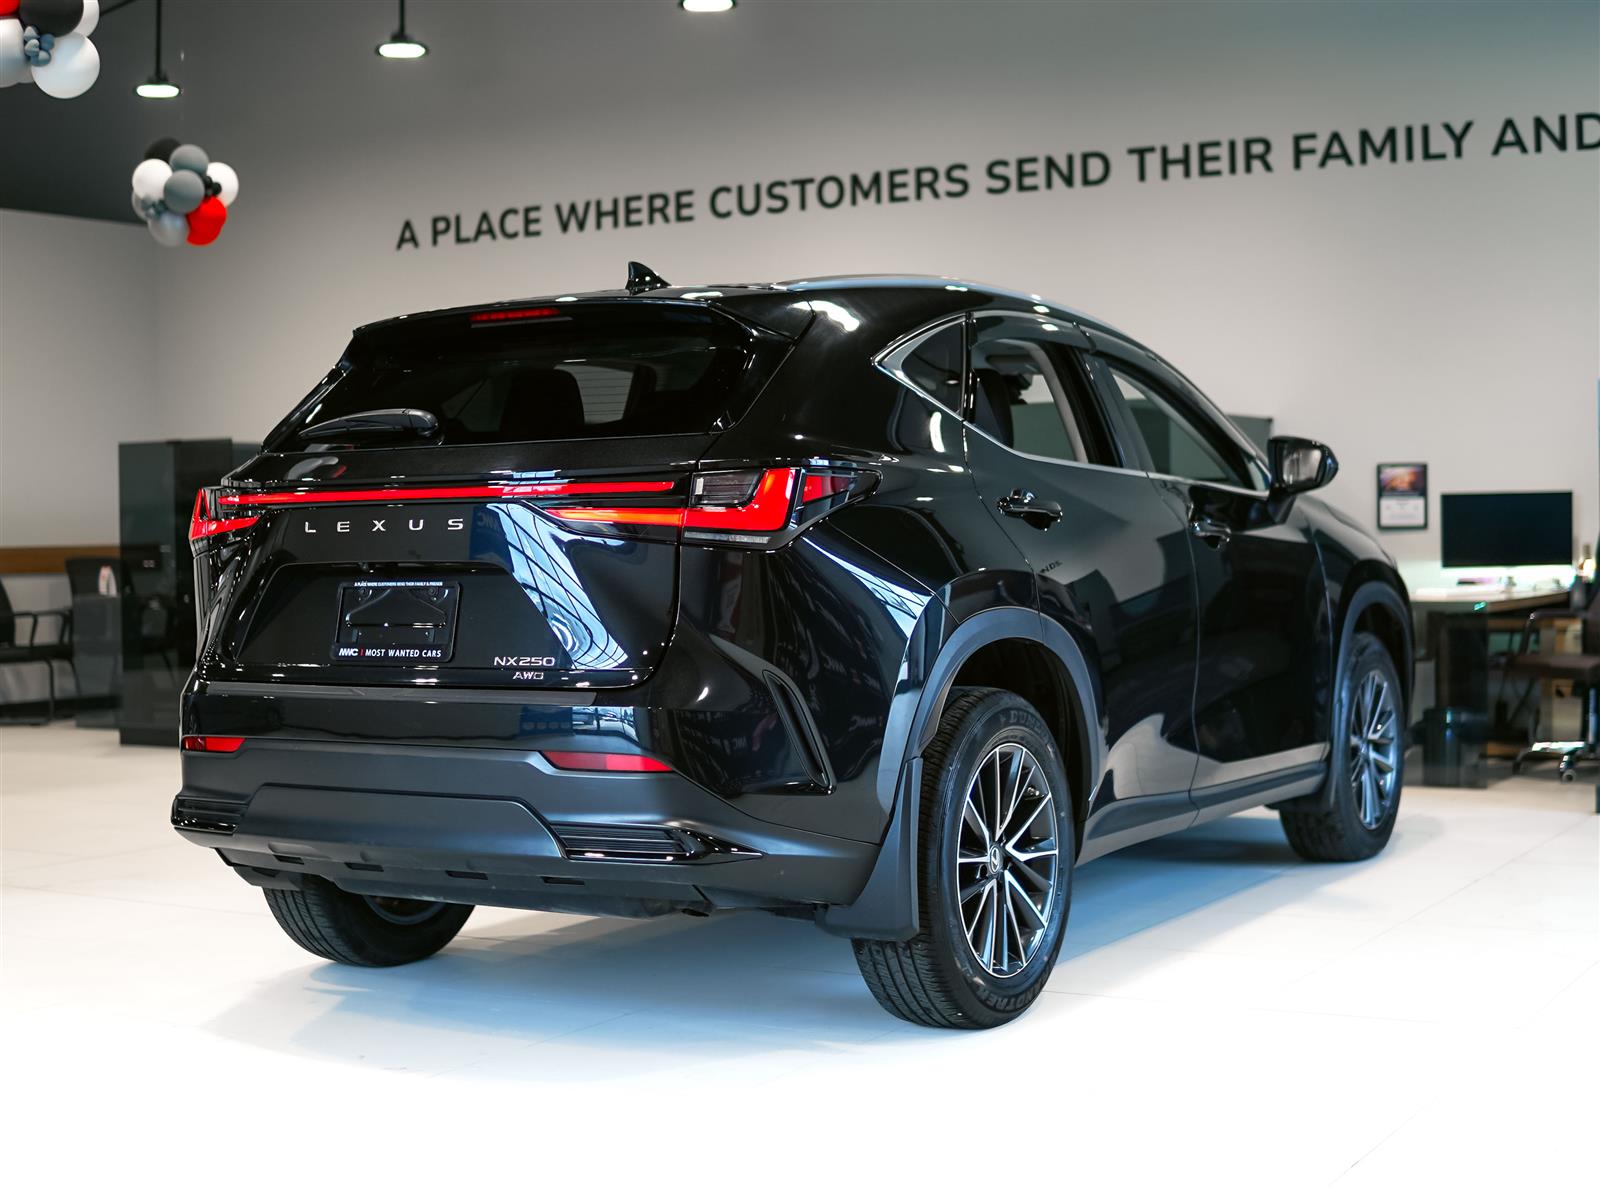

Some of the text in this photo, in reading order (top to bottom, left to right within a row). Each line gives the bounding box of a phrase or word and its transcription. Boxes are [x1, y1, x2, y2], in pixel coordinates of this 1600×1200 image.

[395, 111, 1600, 252] A PLACE WHERE CUSTOMERS SEND THEIR FAMILY AND
[304, 518, 464, 533] LEXUS
[365, 648, 386, 657] MOST
[388, 649, 420, 658] WANTED
[422, 649, 442, 658] CARS
[493, 656, 556, 667] NX250
[512, 671, 545, 680] AWD
